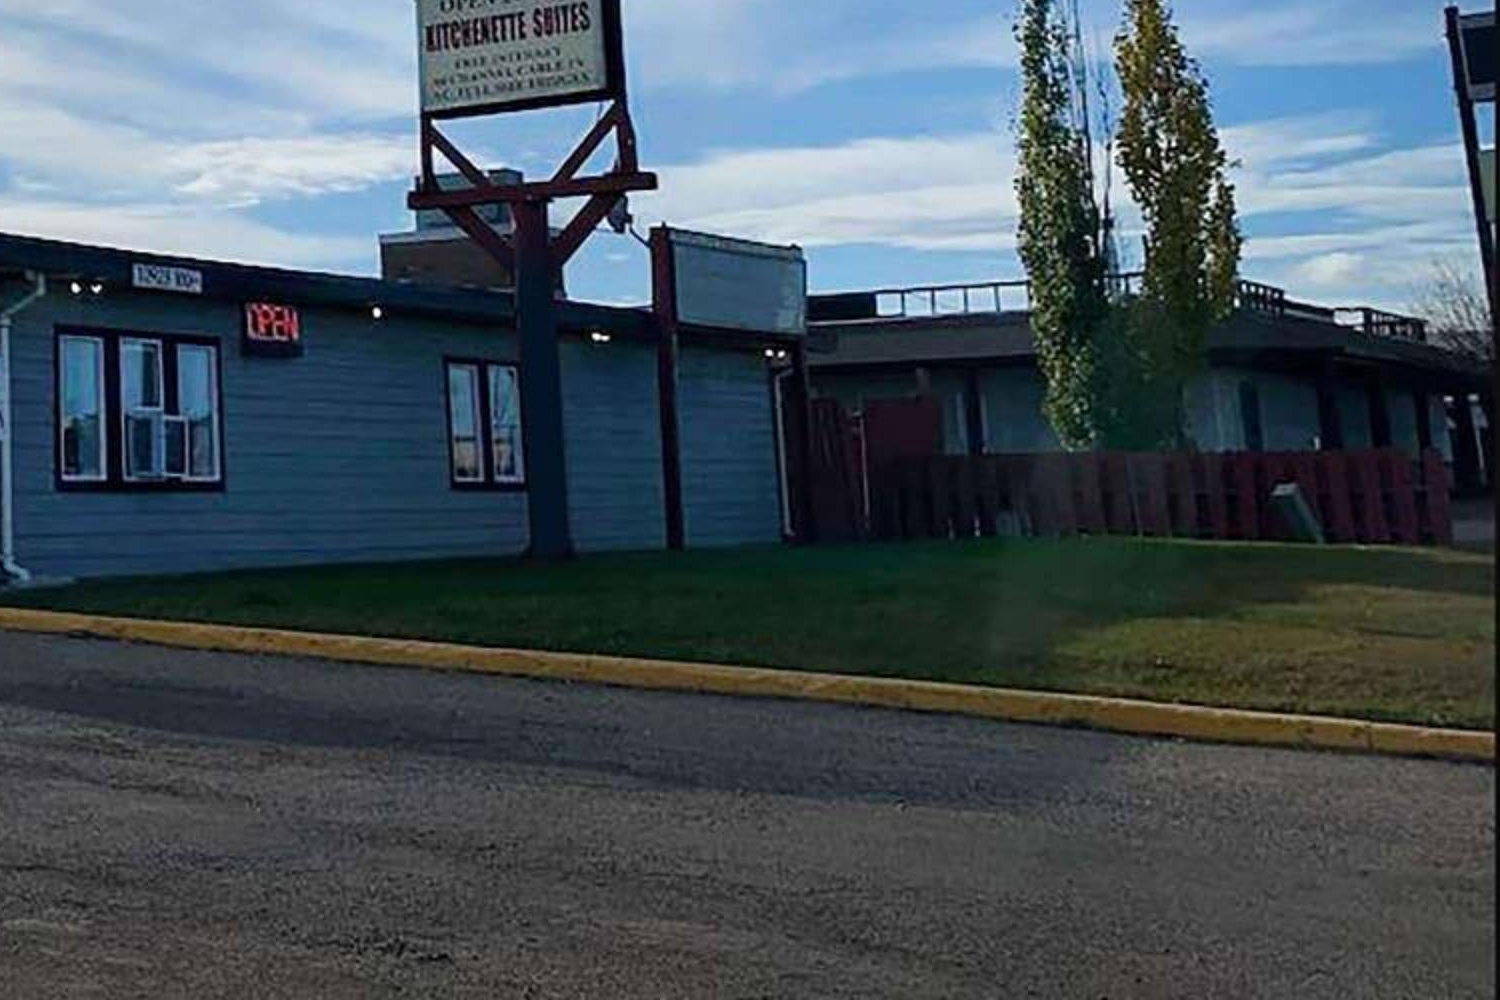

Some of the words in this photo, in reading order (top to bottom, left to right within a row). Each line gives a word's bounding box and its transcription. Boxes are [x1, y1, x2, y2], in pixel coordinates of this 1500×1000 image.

[425, 11, 527, 52] KITCHENETTE
[533, 1, 591, 37] SUITES
[246, 303, 299, 340] OPEN
